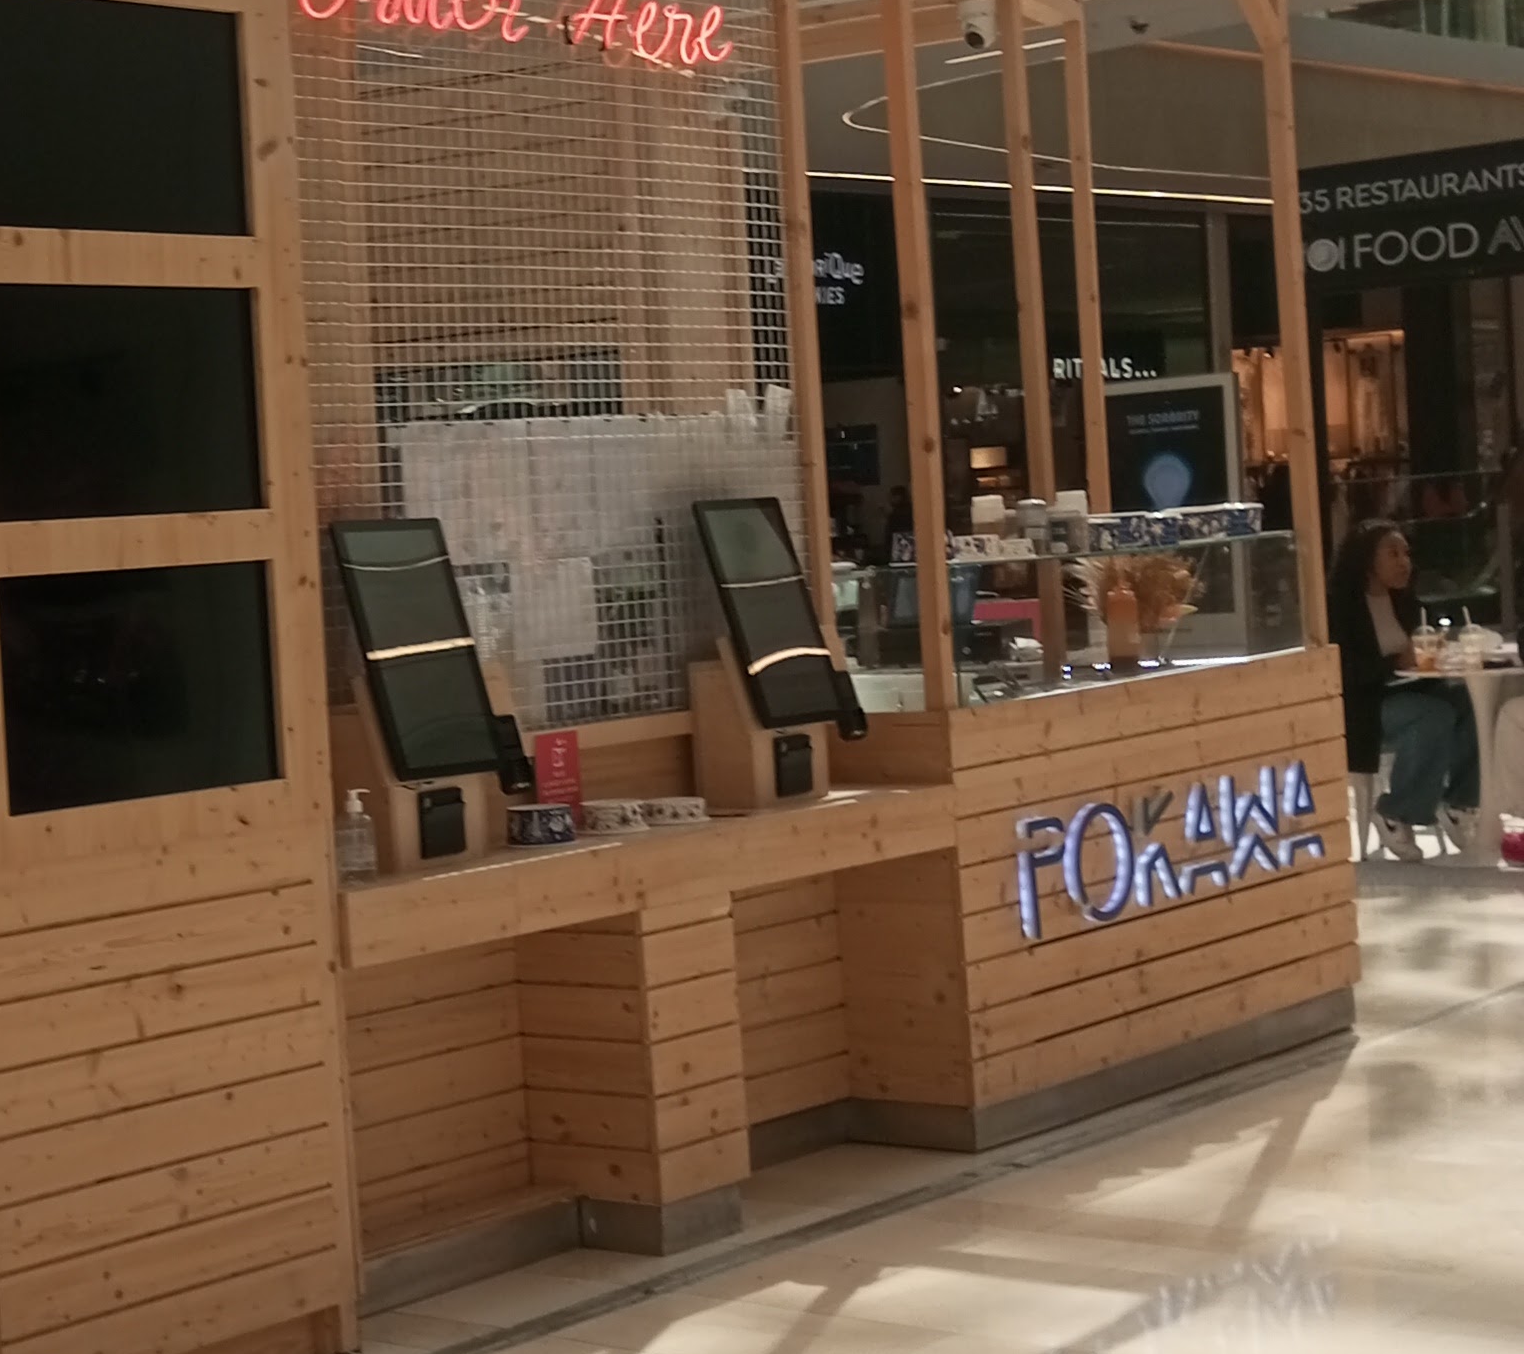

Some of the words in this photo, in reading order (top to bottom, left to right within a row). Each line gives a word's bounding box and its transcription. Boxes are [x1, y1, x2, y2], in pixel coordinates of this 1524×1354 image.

[1298, 188, 1330, 215] 35
[1353, 222, 1480, 269] FOOD
[1053, 357, 1157, 379] RITALS...
[1014, 759, 1326, 940] POKAWA
